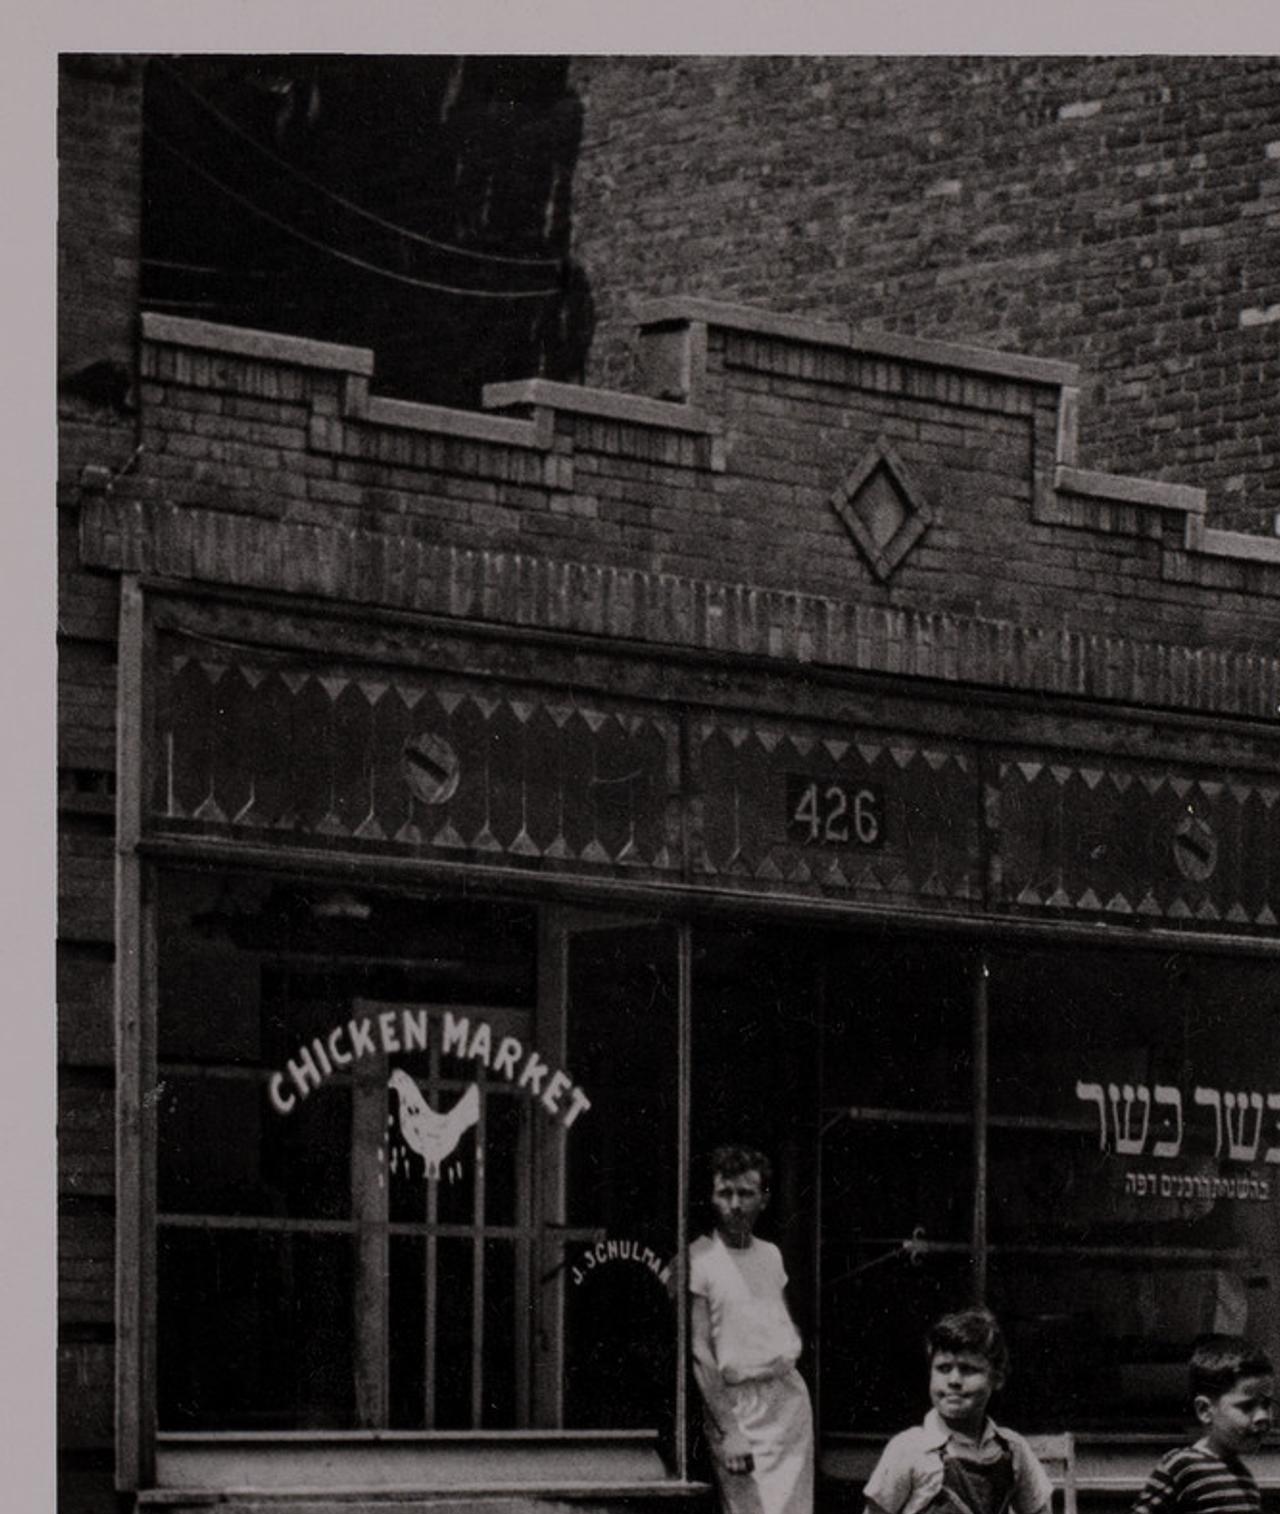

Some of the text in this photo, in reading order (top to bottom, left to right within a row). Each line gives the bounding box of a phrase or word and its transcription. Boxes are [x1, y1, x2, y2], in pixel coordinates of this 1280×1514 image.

[793, 782, 878, 844] 426
[268, 1009, 592, 1128] CHICKEN MARKET
